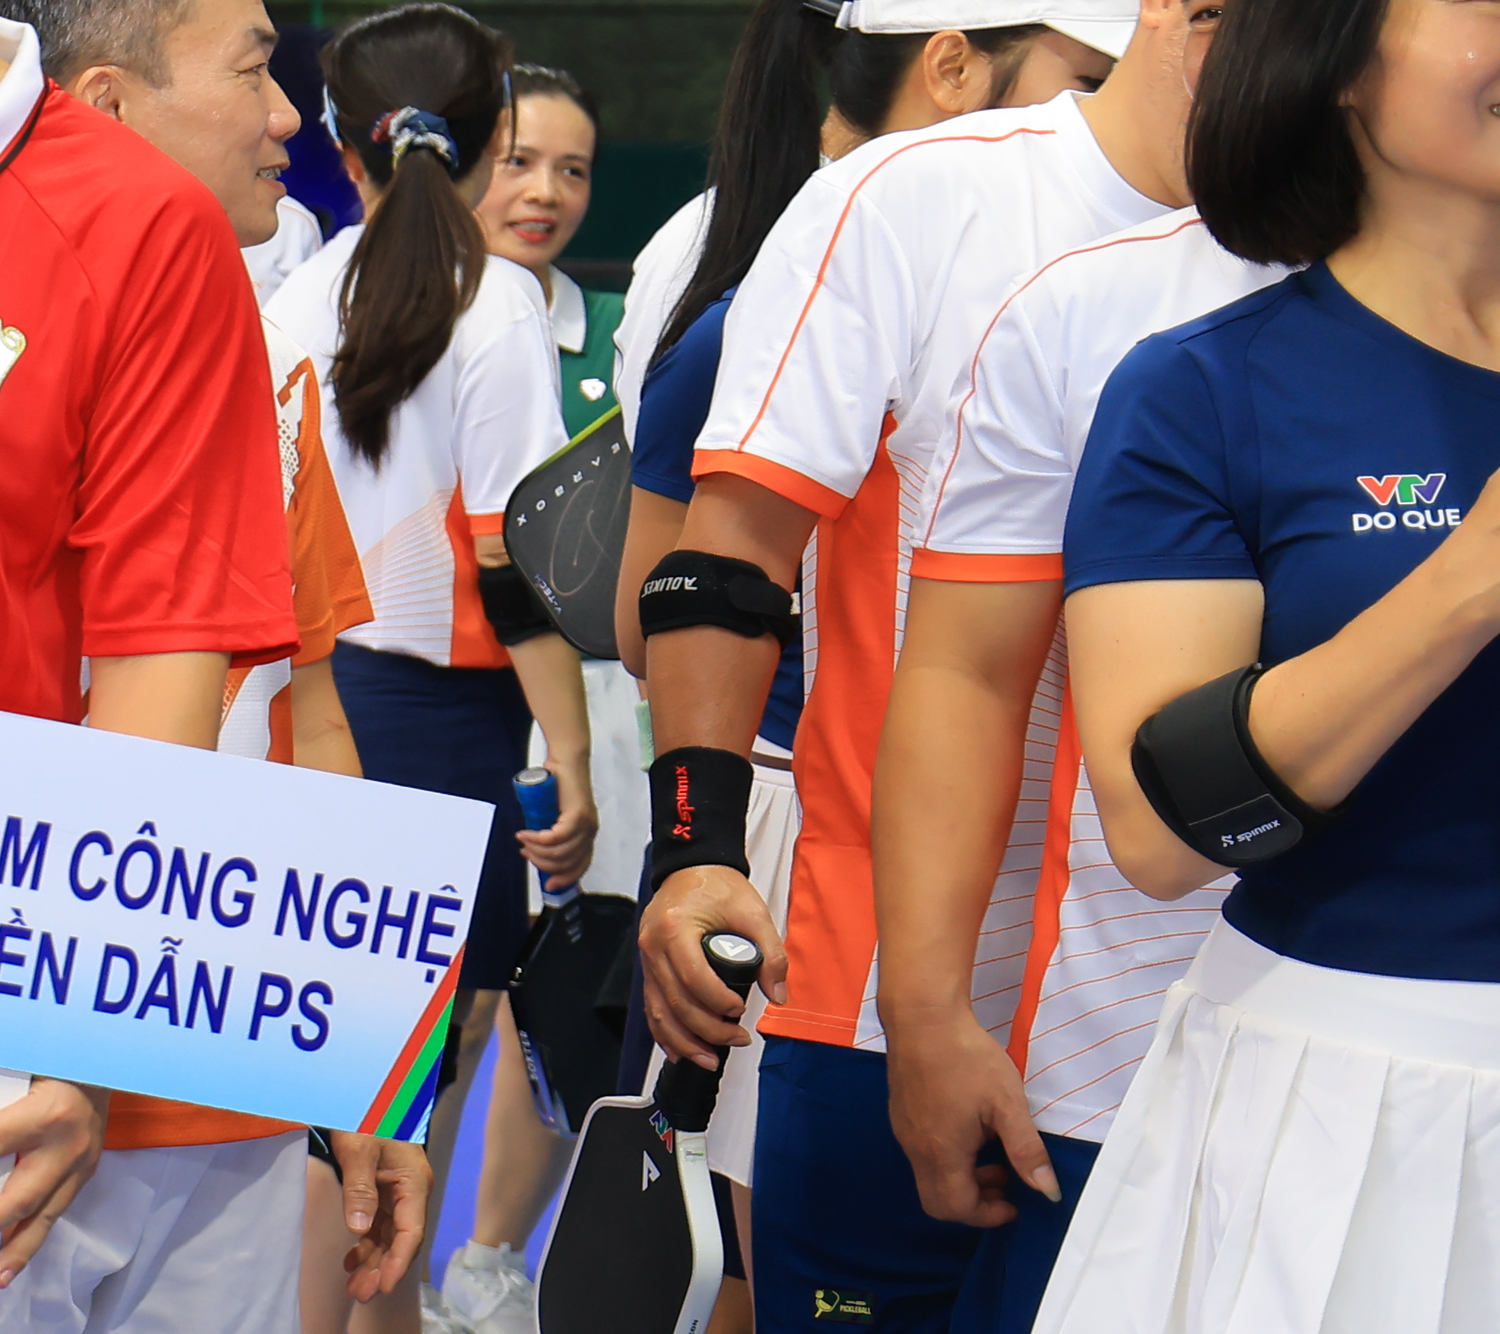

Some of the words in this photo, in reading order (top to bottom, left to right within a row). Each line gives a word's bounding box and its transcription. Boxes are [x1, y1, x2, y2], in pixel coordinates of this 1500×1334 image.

[516, 441, 621, 527] EARBOX
[1352, 511, 1397, 532] DO
[1357, 473, 1446, 505] VTV
[68, 821, 258, 929] CÔNG
[275, 867, 463, 985] NGHỆ
[100, 937, 233, 1035] DẪN
[247, 973, 335, 1053] PS
